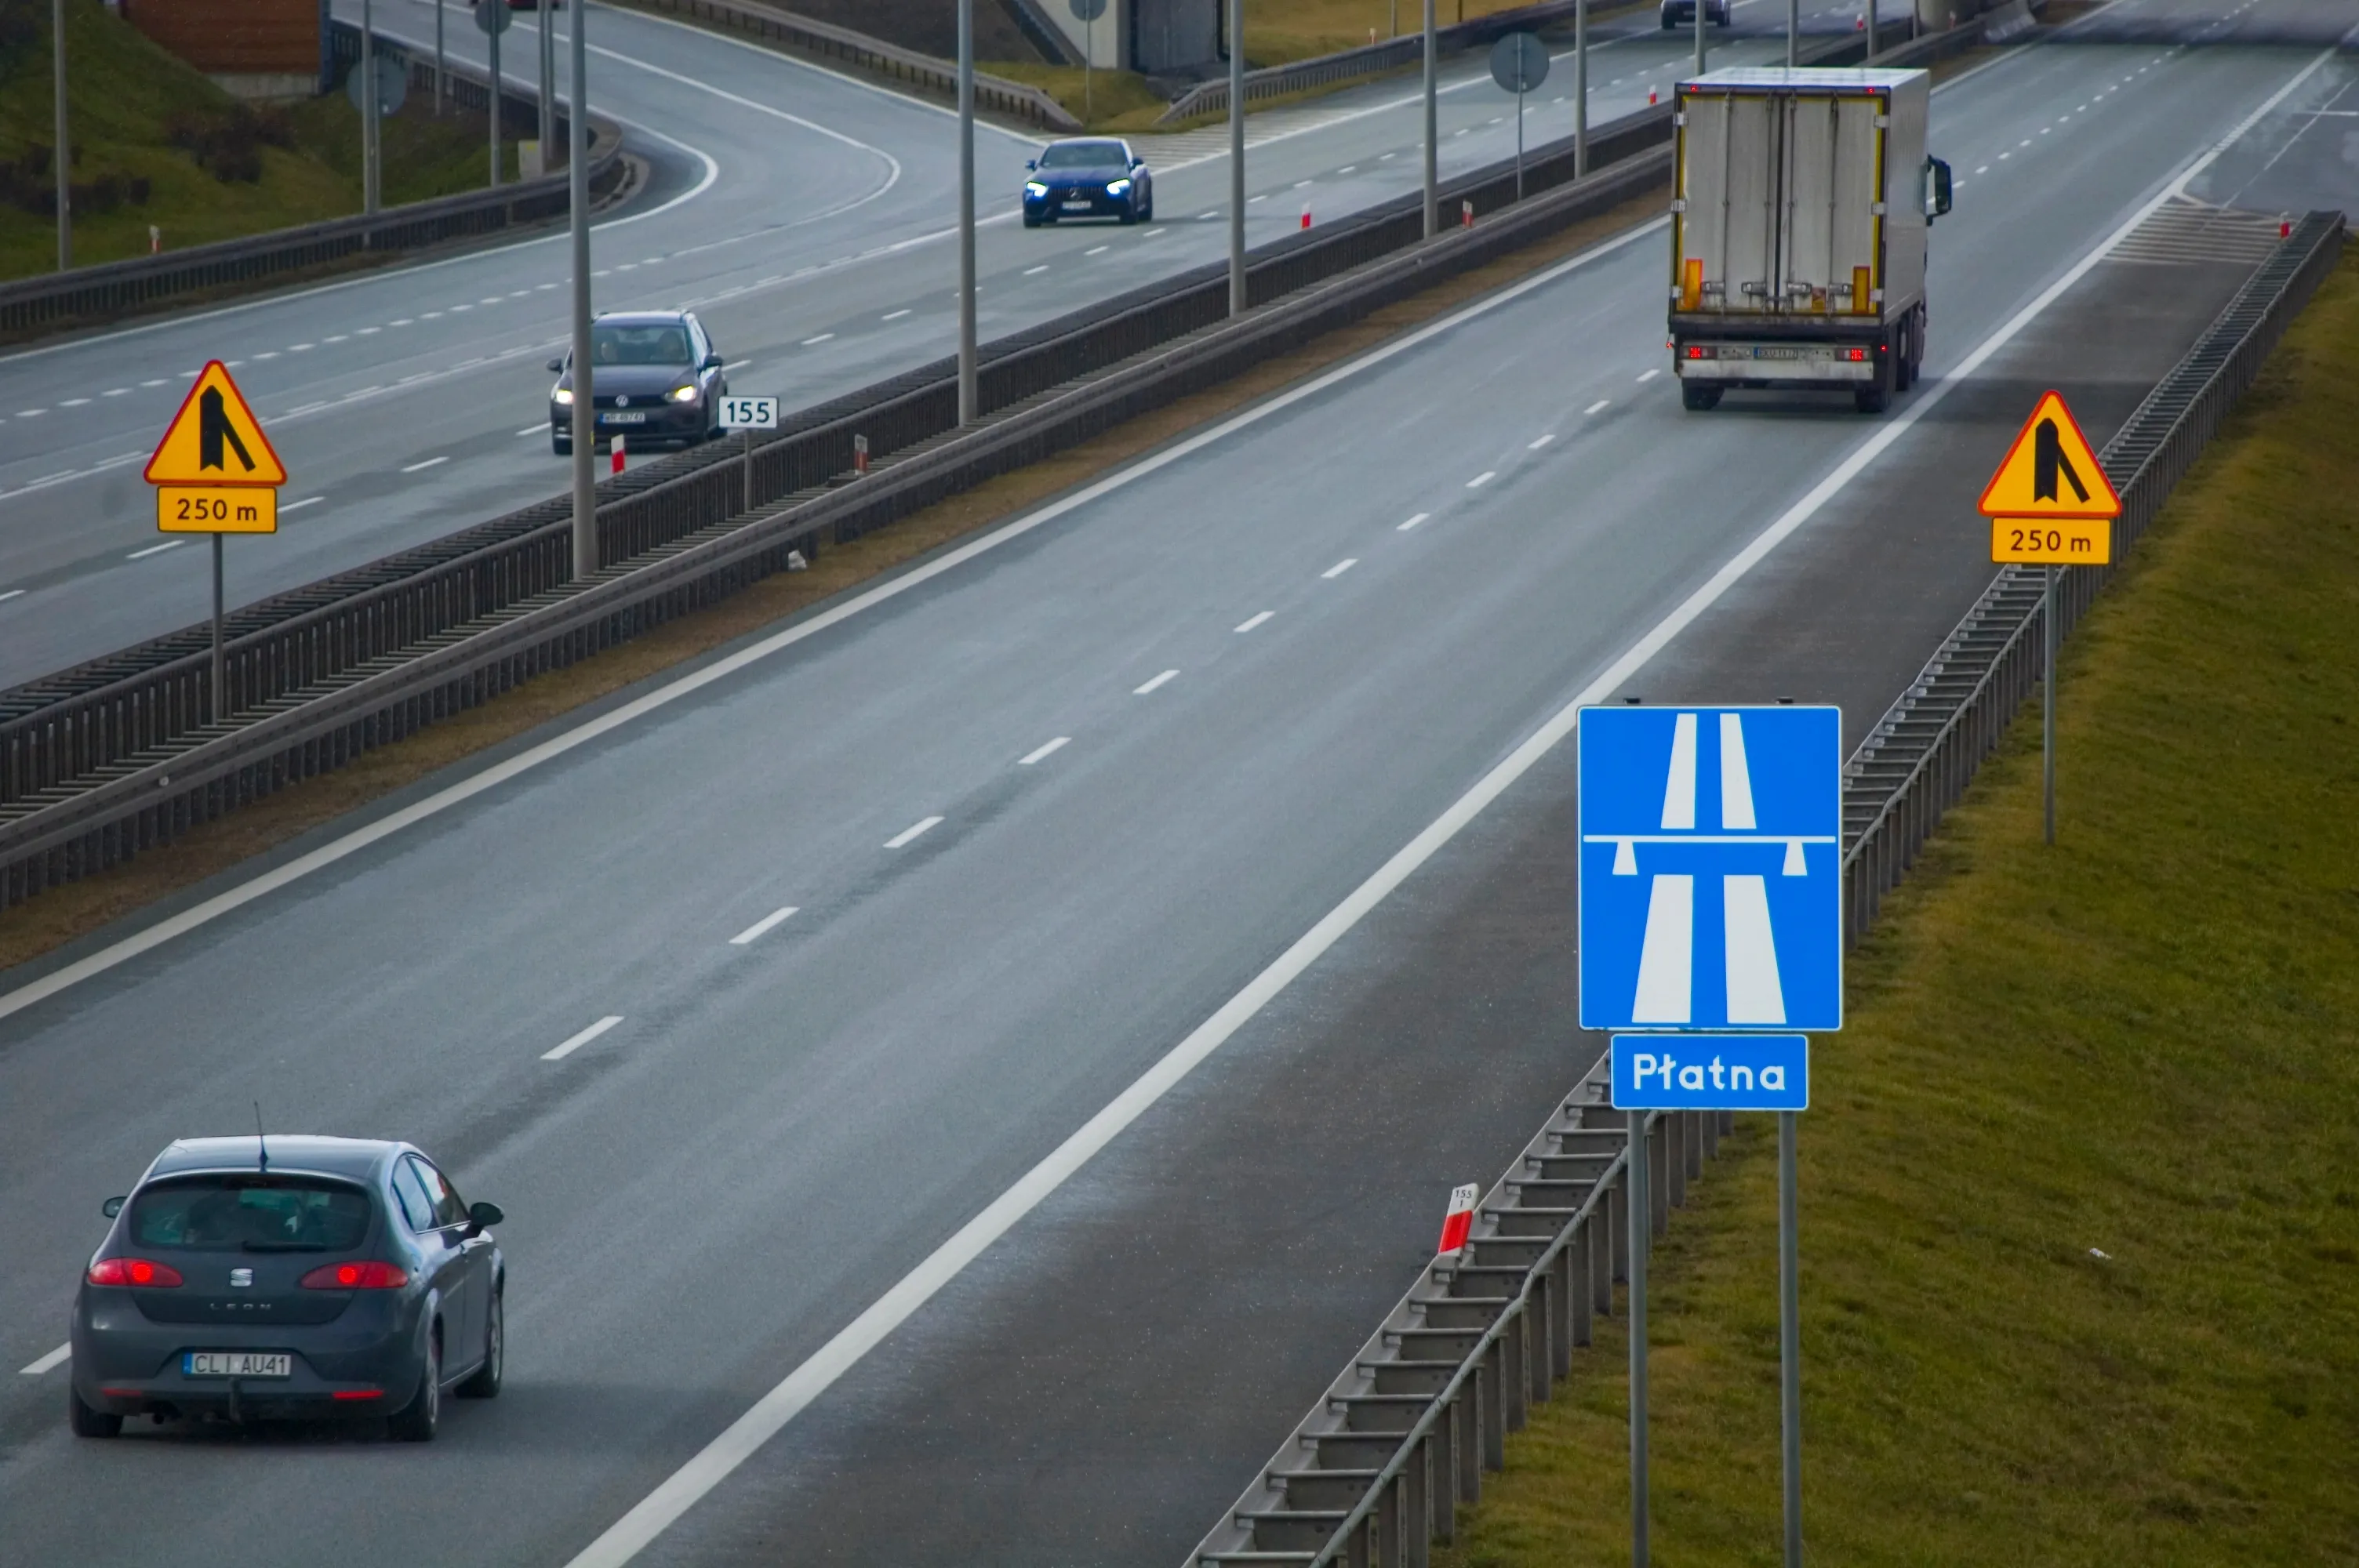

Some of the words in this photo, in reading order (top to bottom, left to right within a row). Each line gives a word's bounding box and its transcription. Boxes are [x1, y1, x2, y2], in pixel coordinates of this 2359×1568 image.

[727, 401, 770, 423] 155
[176, 498, 227, 521] 250
[236, 506, 257, 521] m
[2010, 529, 2062, 552] 250
[2070, 537, 2092, 553] m
[1633, 1053, 1786, 1091] Płatna
[1456, 1189, 1472, 1199] 155
[241, 1356, 286, 1374] AU41
